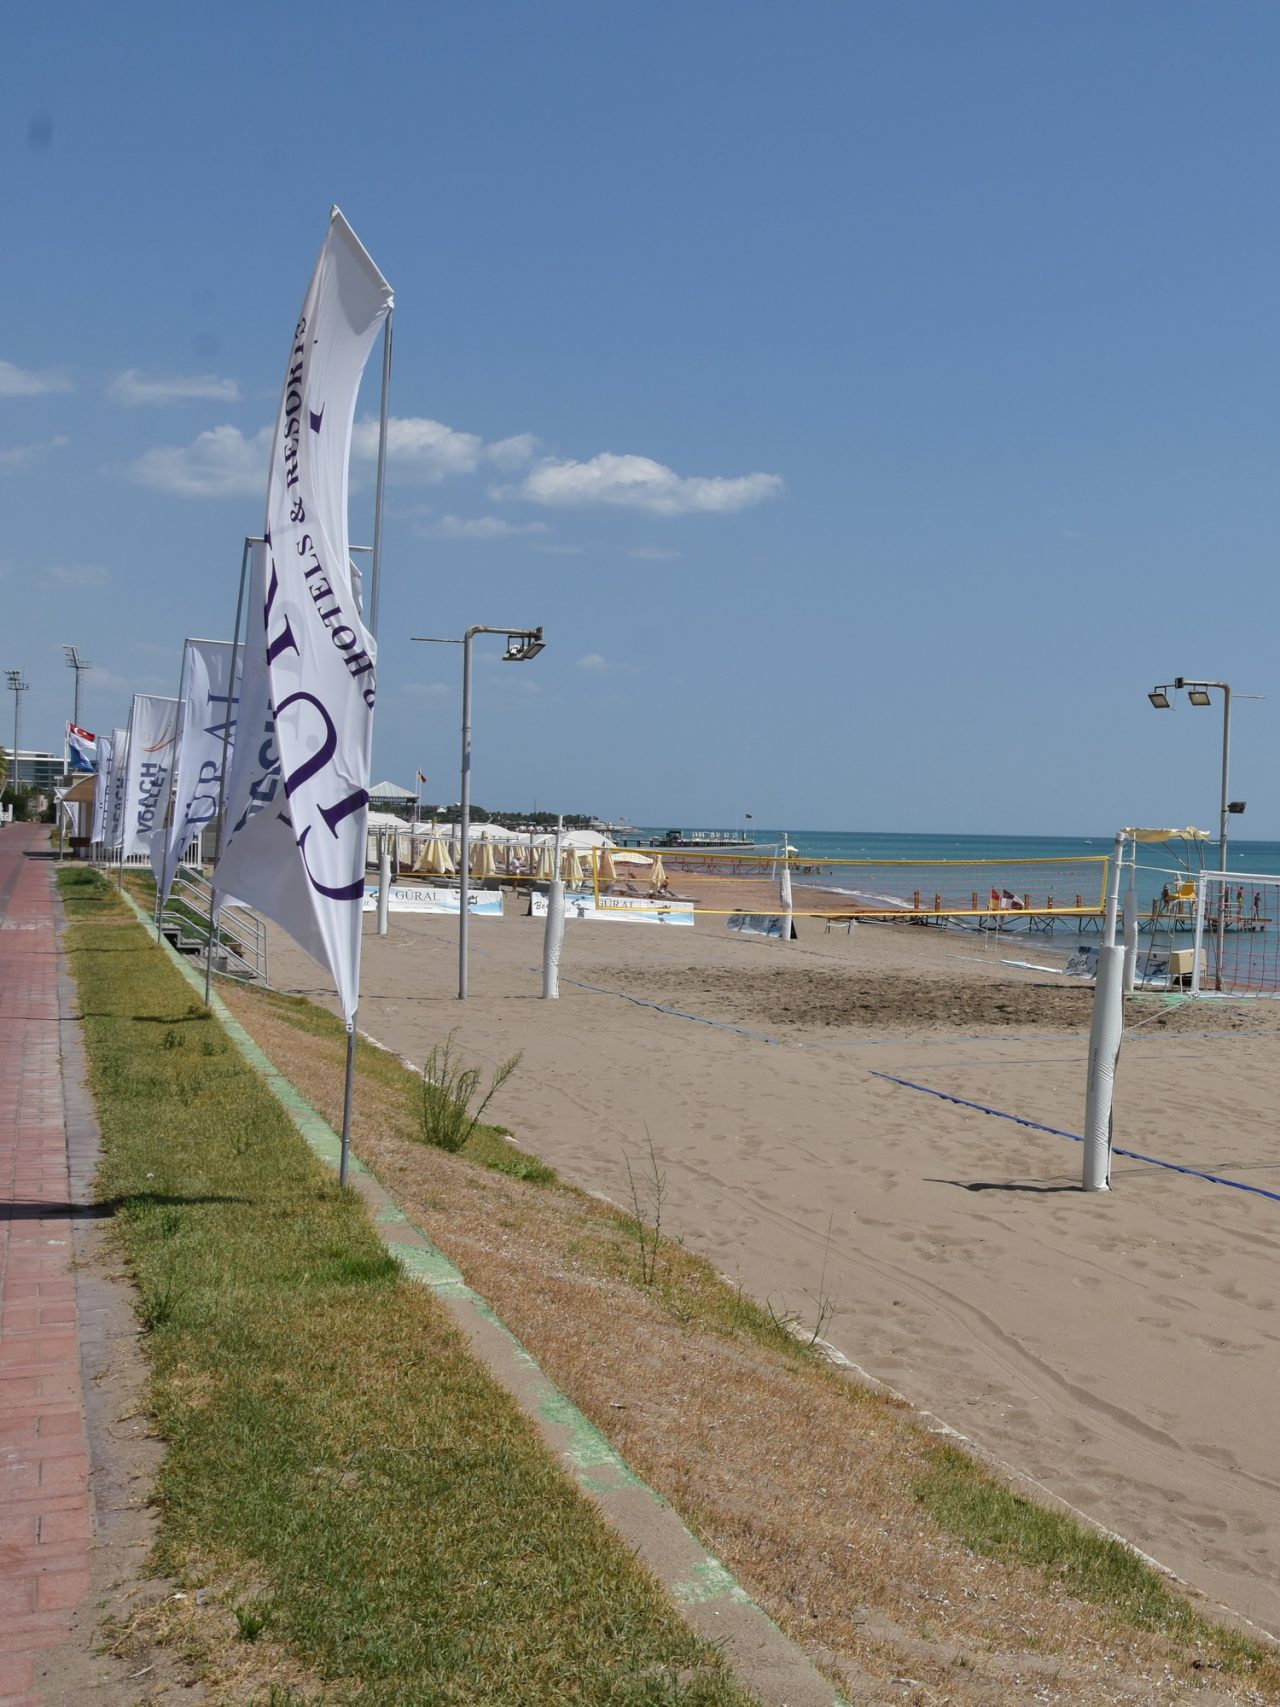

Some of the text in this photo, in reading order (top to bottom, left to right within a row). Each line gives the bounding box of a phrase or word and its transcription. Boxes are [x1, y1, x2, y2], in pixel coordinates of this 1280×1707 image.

[290, 496, 306, 523] &
[296, 533, 375, 680] HOTELS
[395, 889, 441, 901] GÜRAL
